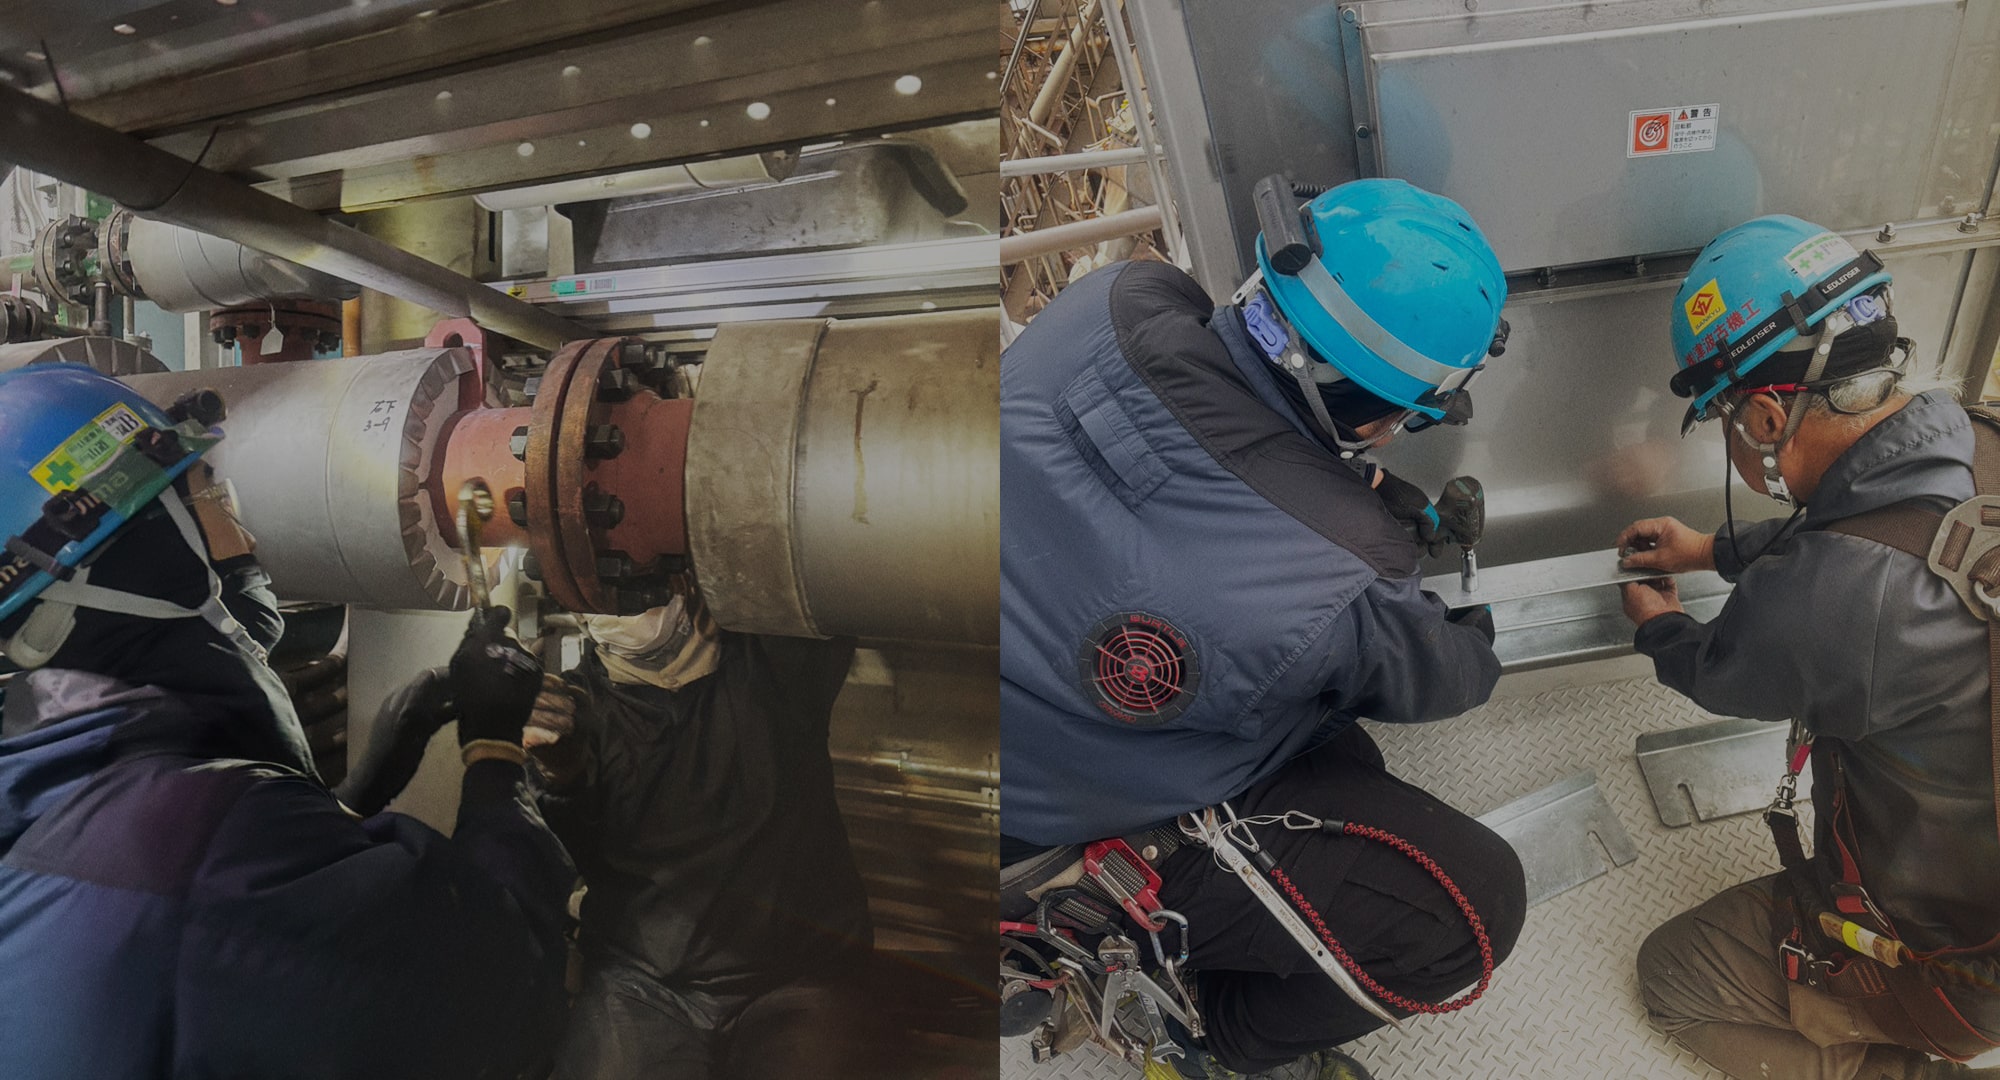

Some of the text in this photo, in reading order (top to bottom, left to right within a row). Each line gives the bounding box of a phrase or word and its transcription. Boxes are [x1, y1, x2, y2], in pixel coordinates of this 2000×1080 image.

[1691, 108, 1711, 118] 警告
[1822, 266, 1861, 295] LEDLENSER
[1695, 307, 1721, 331] SANKYU
[1728, 321, 1777, 358] EDLENSER
[1129, 614, 1187, 649] BURTLE
